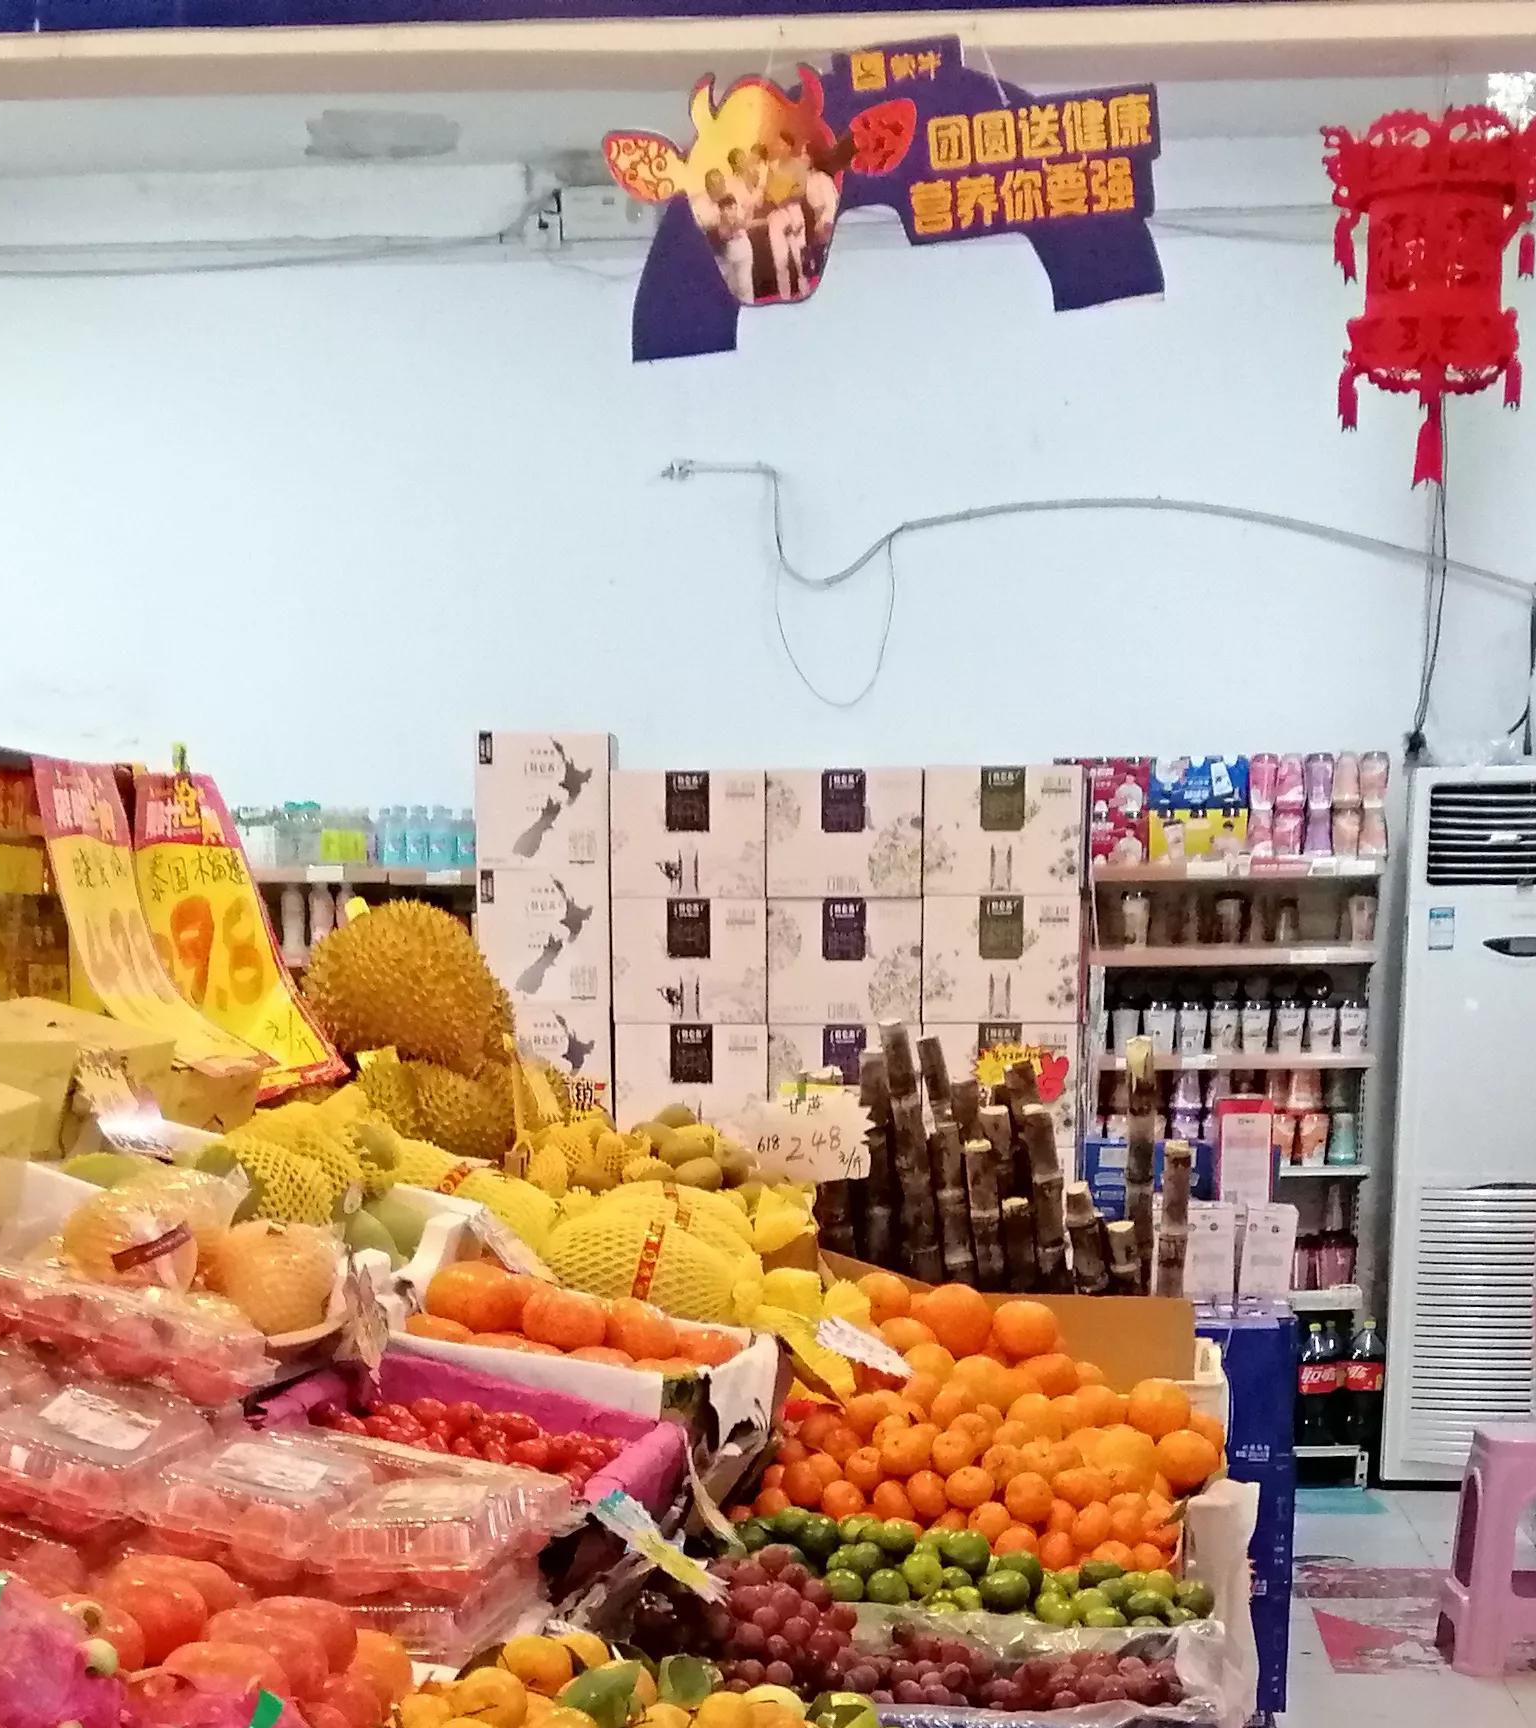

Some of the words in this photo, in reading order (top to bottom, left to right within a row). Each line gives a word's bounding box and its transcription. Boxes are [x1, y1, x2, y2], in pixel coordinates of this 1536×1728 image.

[927, 92, 1153, 172] 团圆送健康
[910, 155, 1136, 236] 营养你要强
[757, 1133, 781, 1154] 618
